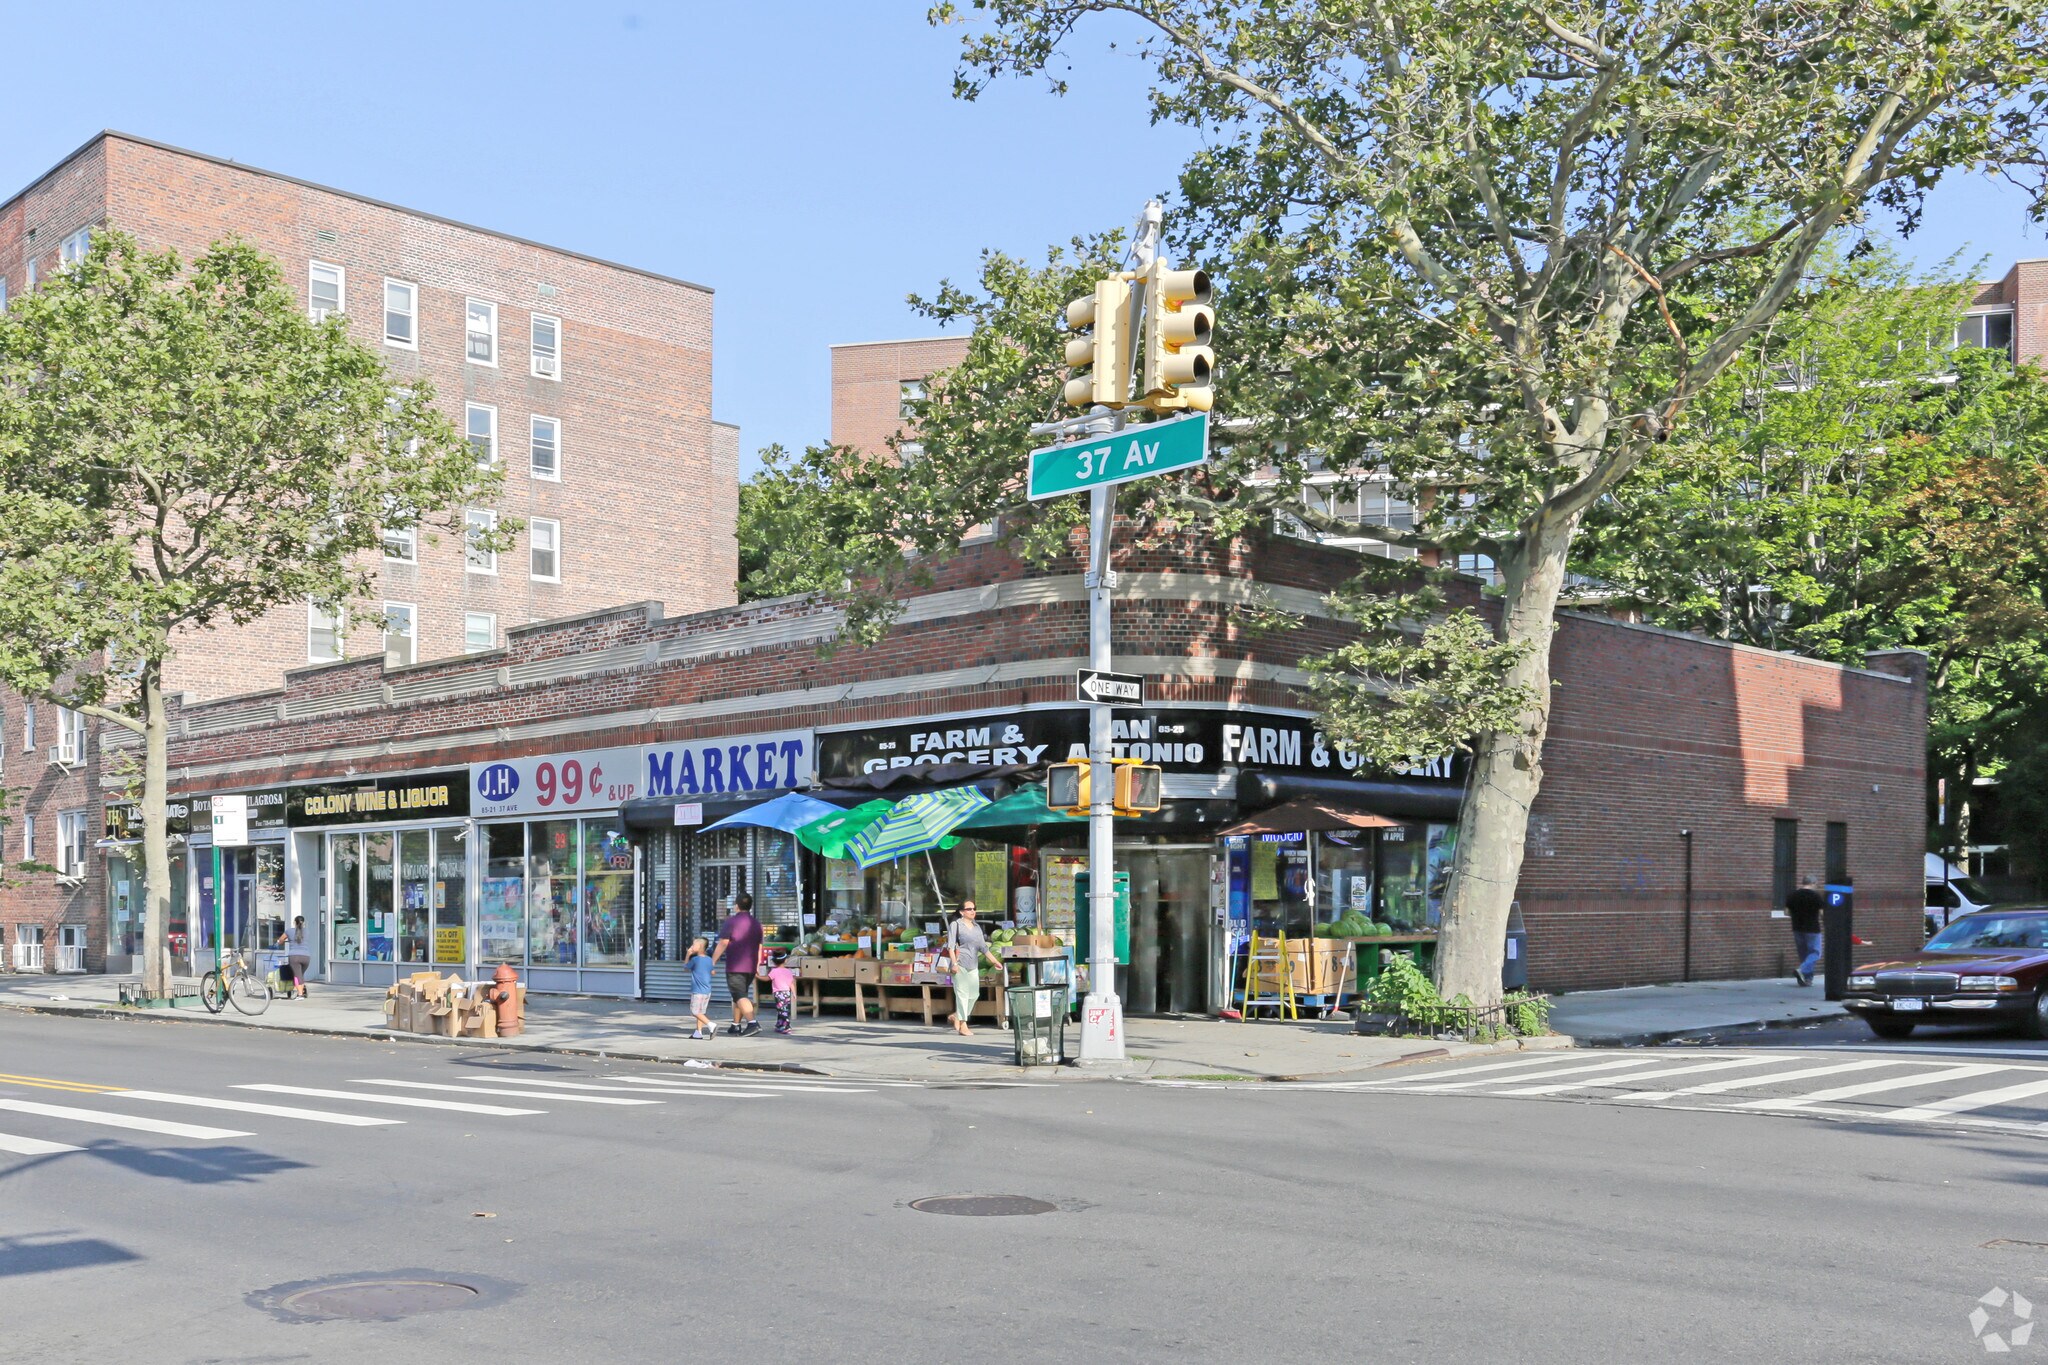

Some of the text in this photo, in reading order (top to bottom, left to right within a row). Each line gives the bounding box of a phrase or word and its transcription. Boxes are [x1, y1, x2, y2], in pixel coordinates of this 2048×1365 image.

[1075, 440, 1160, 480] 37 Av
[1090, 681, 1135, 696] ONE WAY
[910, 724, 1025, 752] FARM &
[1112, 719, 1150, 739] AN
[1068, 742, 1204, 764] ATONIO
[1222, 724, 1300, 766] FARM
[1310, 732, 1330, 768] &
[648, 739, 803, 796] MARKET
[481, 768, 515, 797] J.H.
[247, 794, 283, 807] ILAGROSA
[305, 785, 449, 816] COLONY WINE & LIQUOR
[1832, 893, 1840, 904] P
